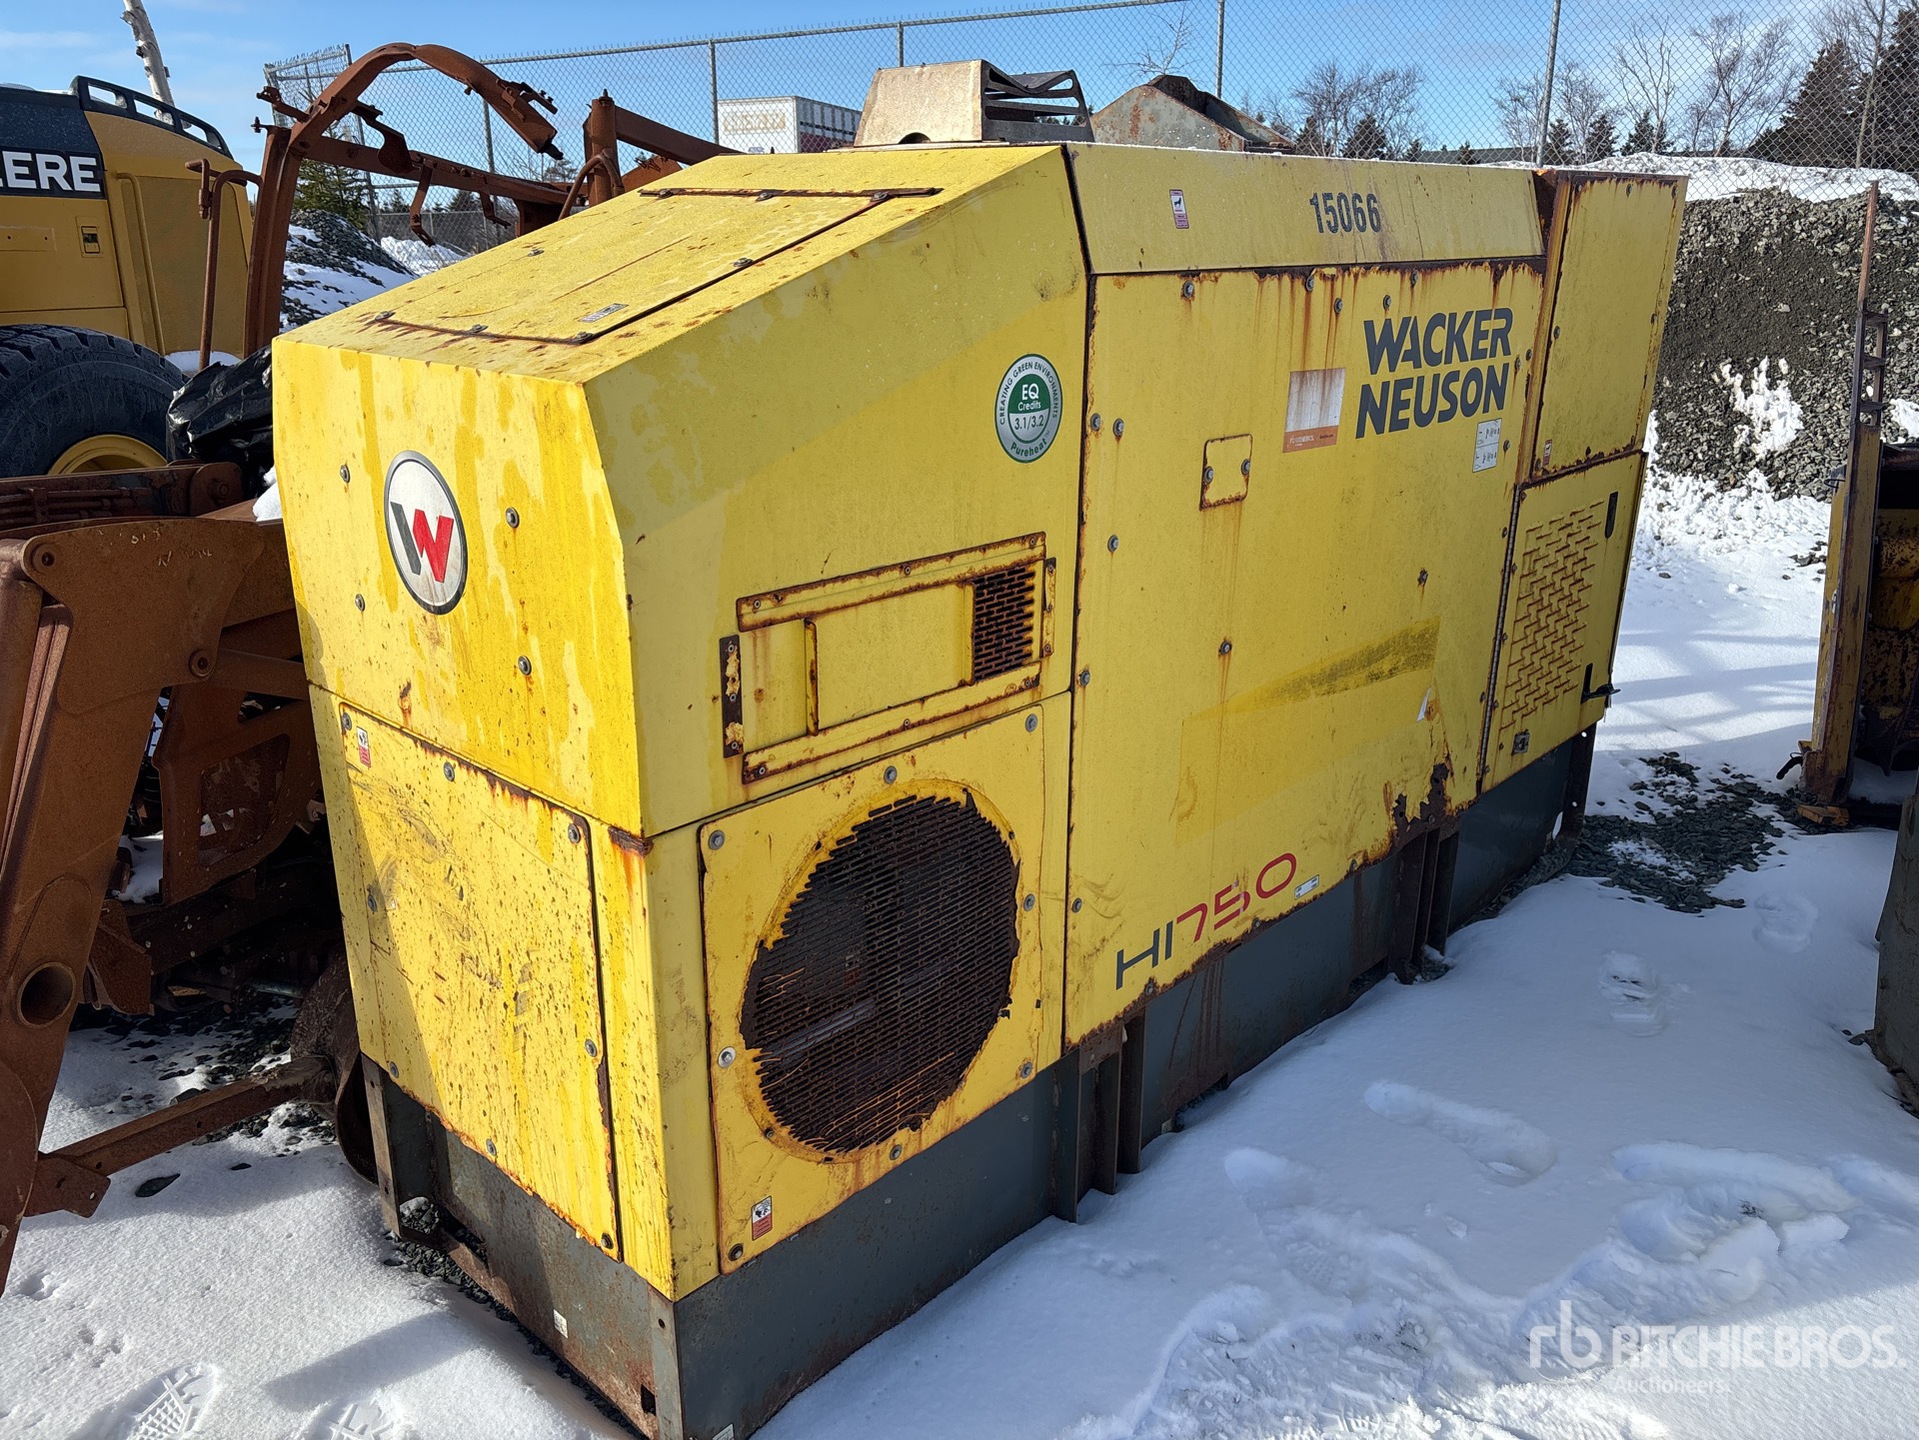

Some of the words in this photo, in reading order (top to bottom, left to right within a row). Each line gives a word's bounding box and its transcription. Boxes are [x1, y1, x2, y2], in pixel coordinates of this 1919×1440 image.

[0, 150, 101, 192] ERE
[1309, 192, 1381, 234] 15066
[1363, 307, 1514, 376] WACKER
[1000, 378, 1013, 425] CREATING
[1013, 361, 1033, 378] GREEN
[1034, 361, 1059, 419] ENVIRONMENTS
[1017, 400, 1042, 412] Credits
[1021, 383, 1040, 401] EQ
[1355, 362, 1510, 439] NEUSON
[1014, 414, 1044, 431] 3.1/3.2
